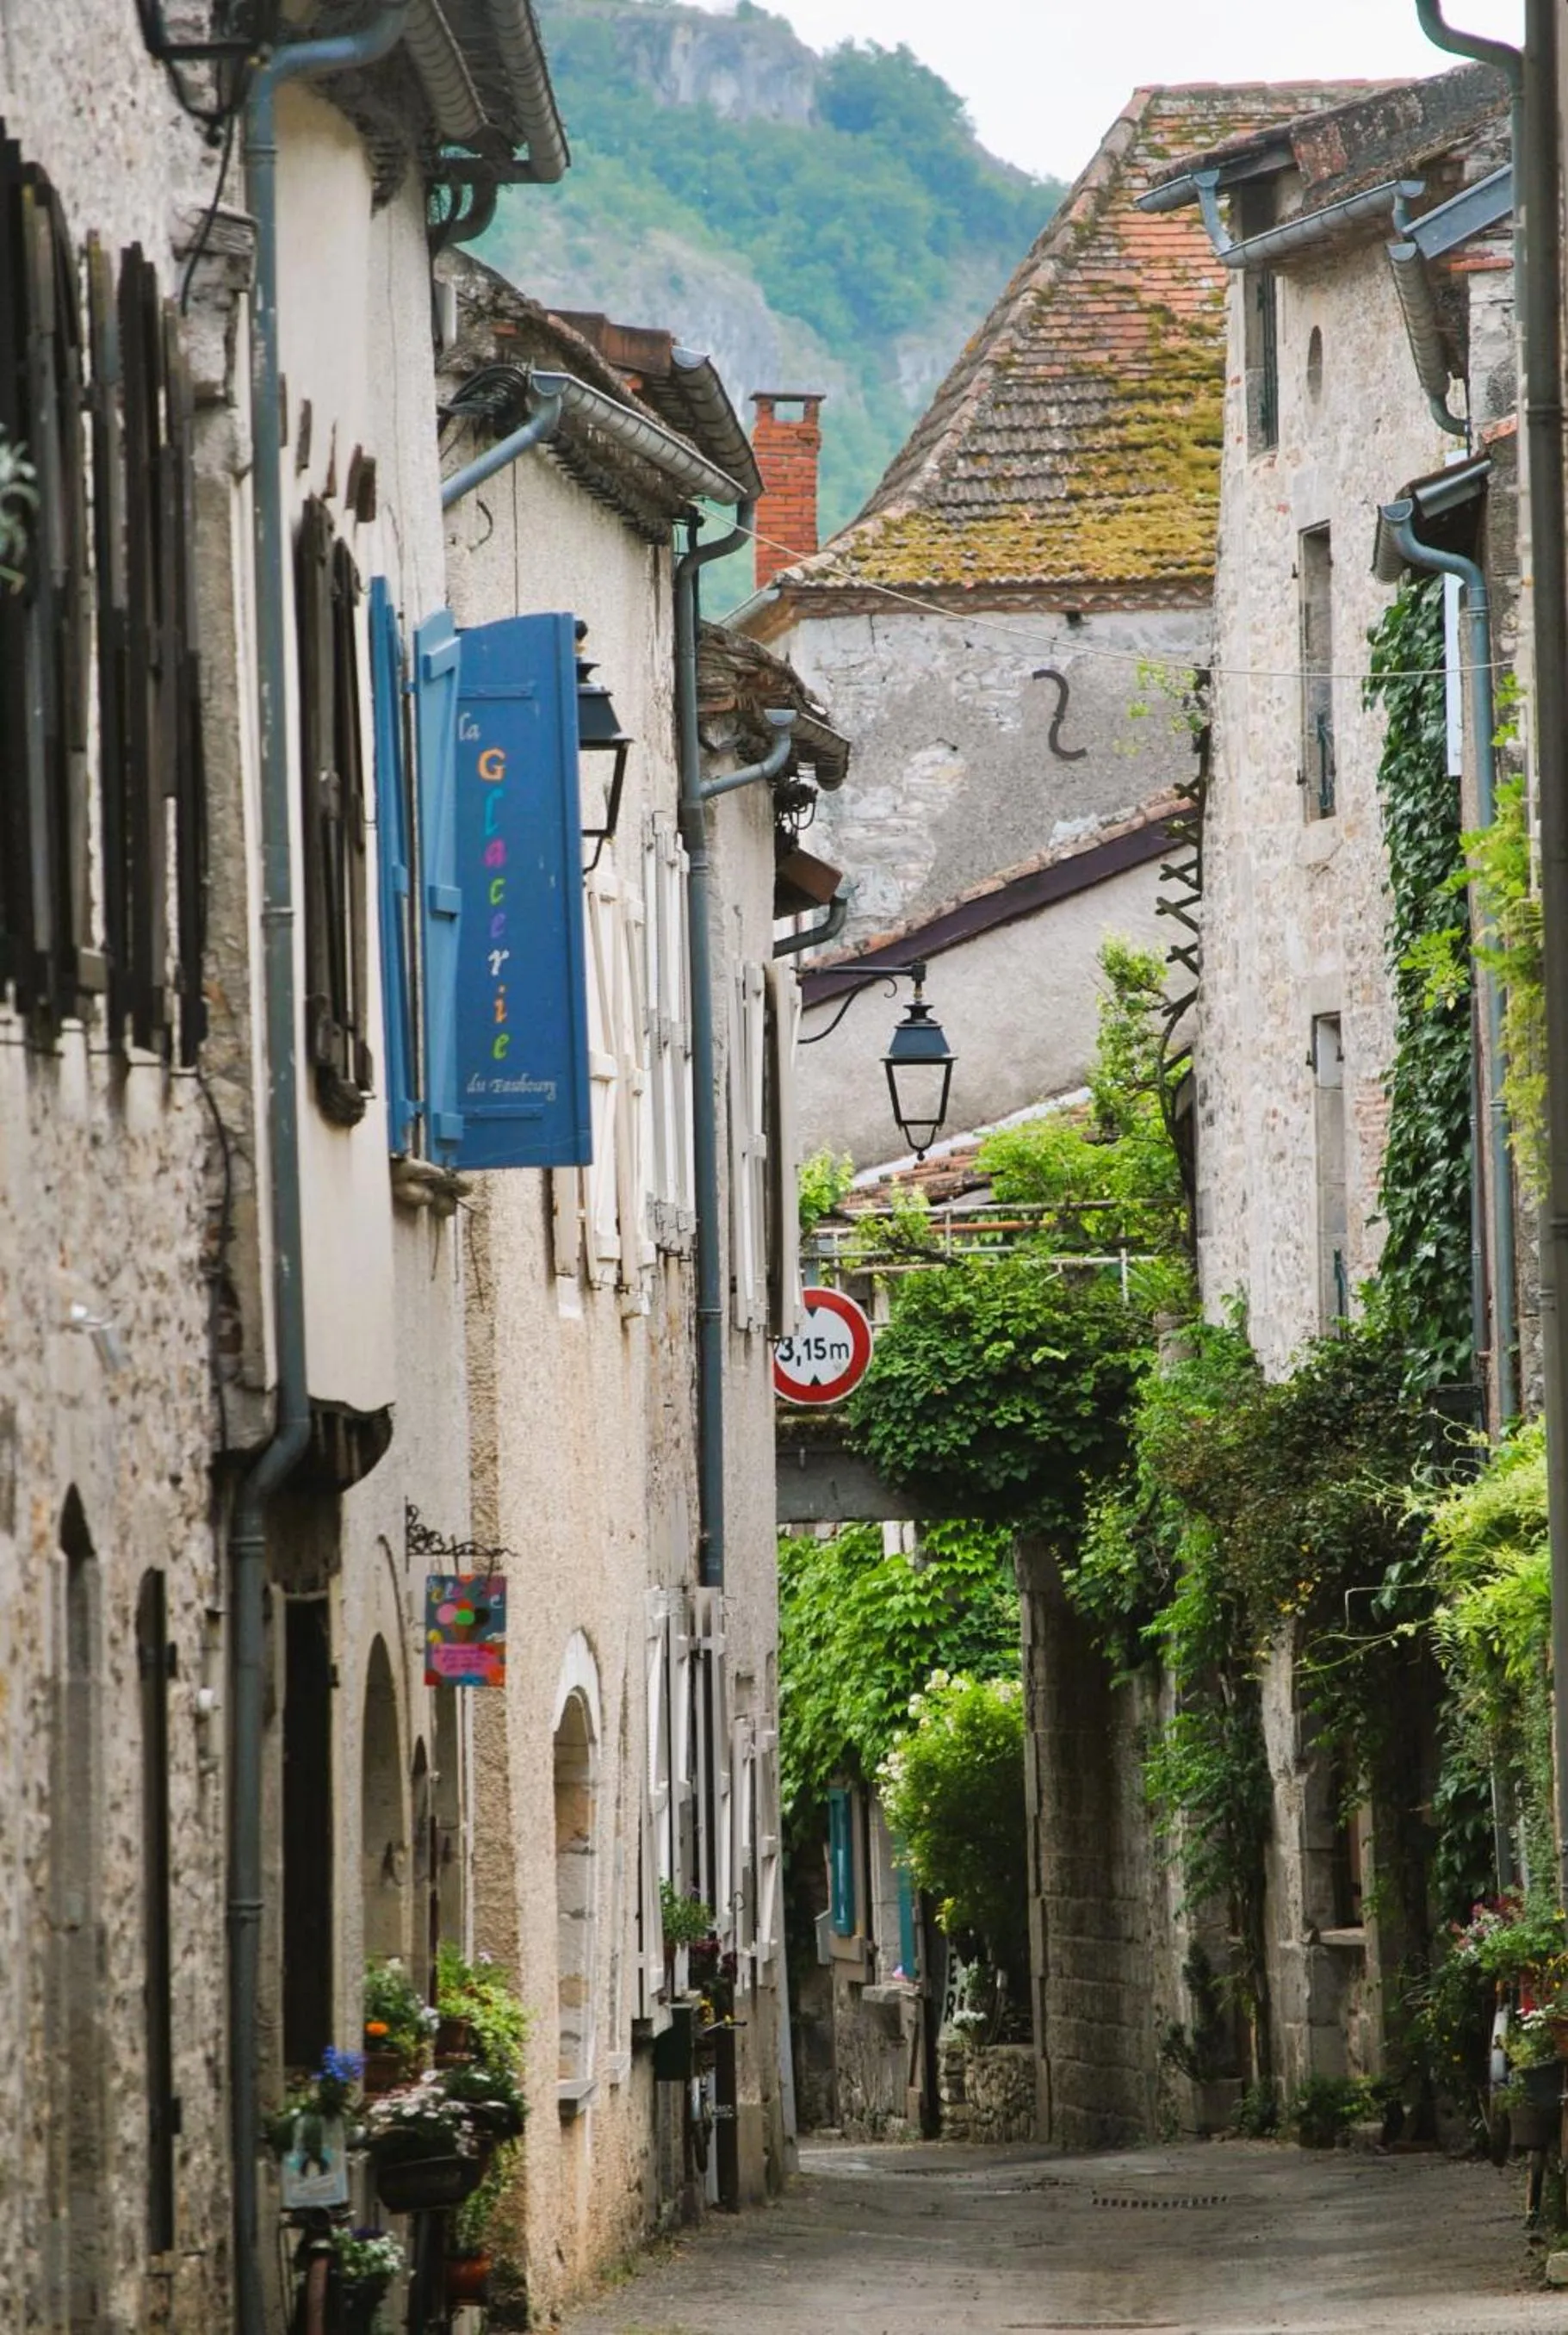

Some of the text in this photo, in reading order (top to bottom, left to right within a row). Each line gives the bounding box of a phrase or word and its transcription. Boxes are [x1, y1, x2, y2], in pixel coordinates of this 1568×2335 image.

[458, 711, 481, 742] la
[477, 746, 511, 1060] Glacerie
[466, 1072, 556, 1101] du Faubourg
